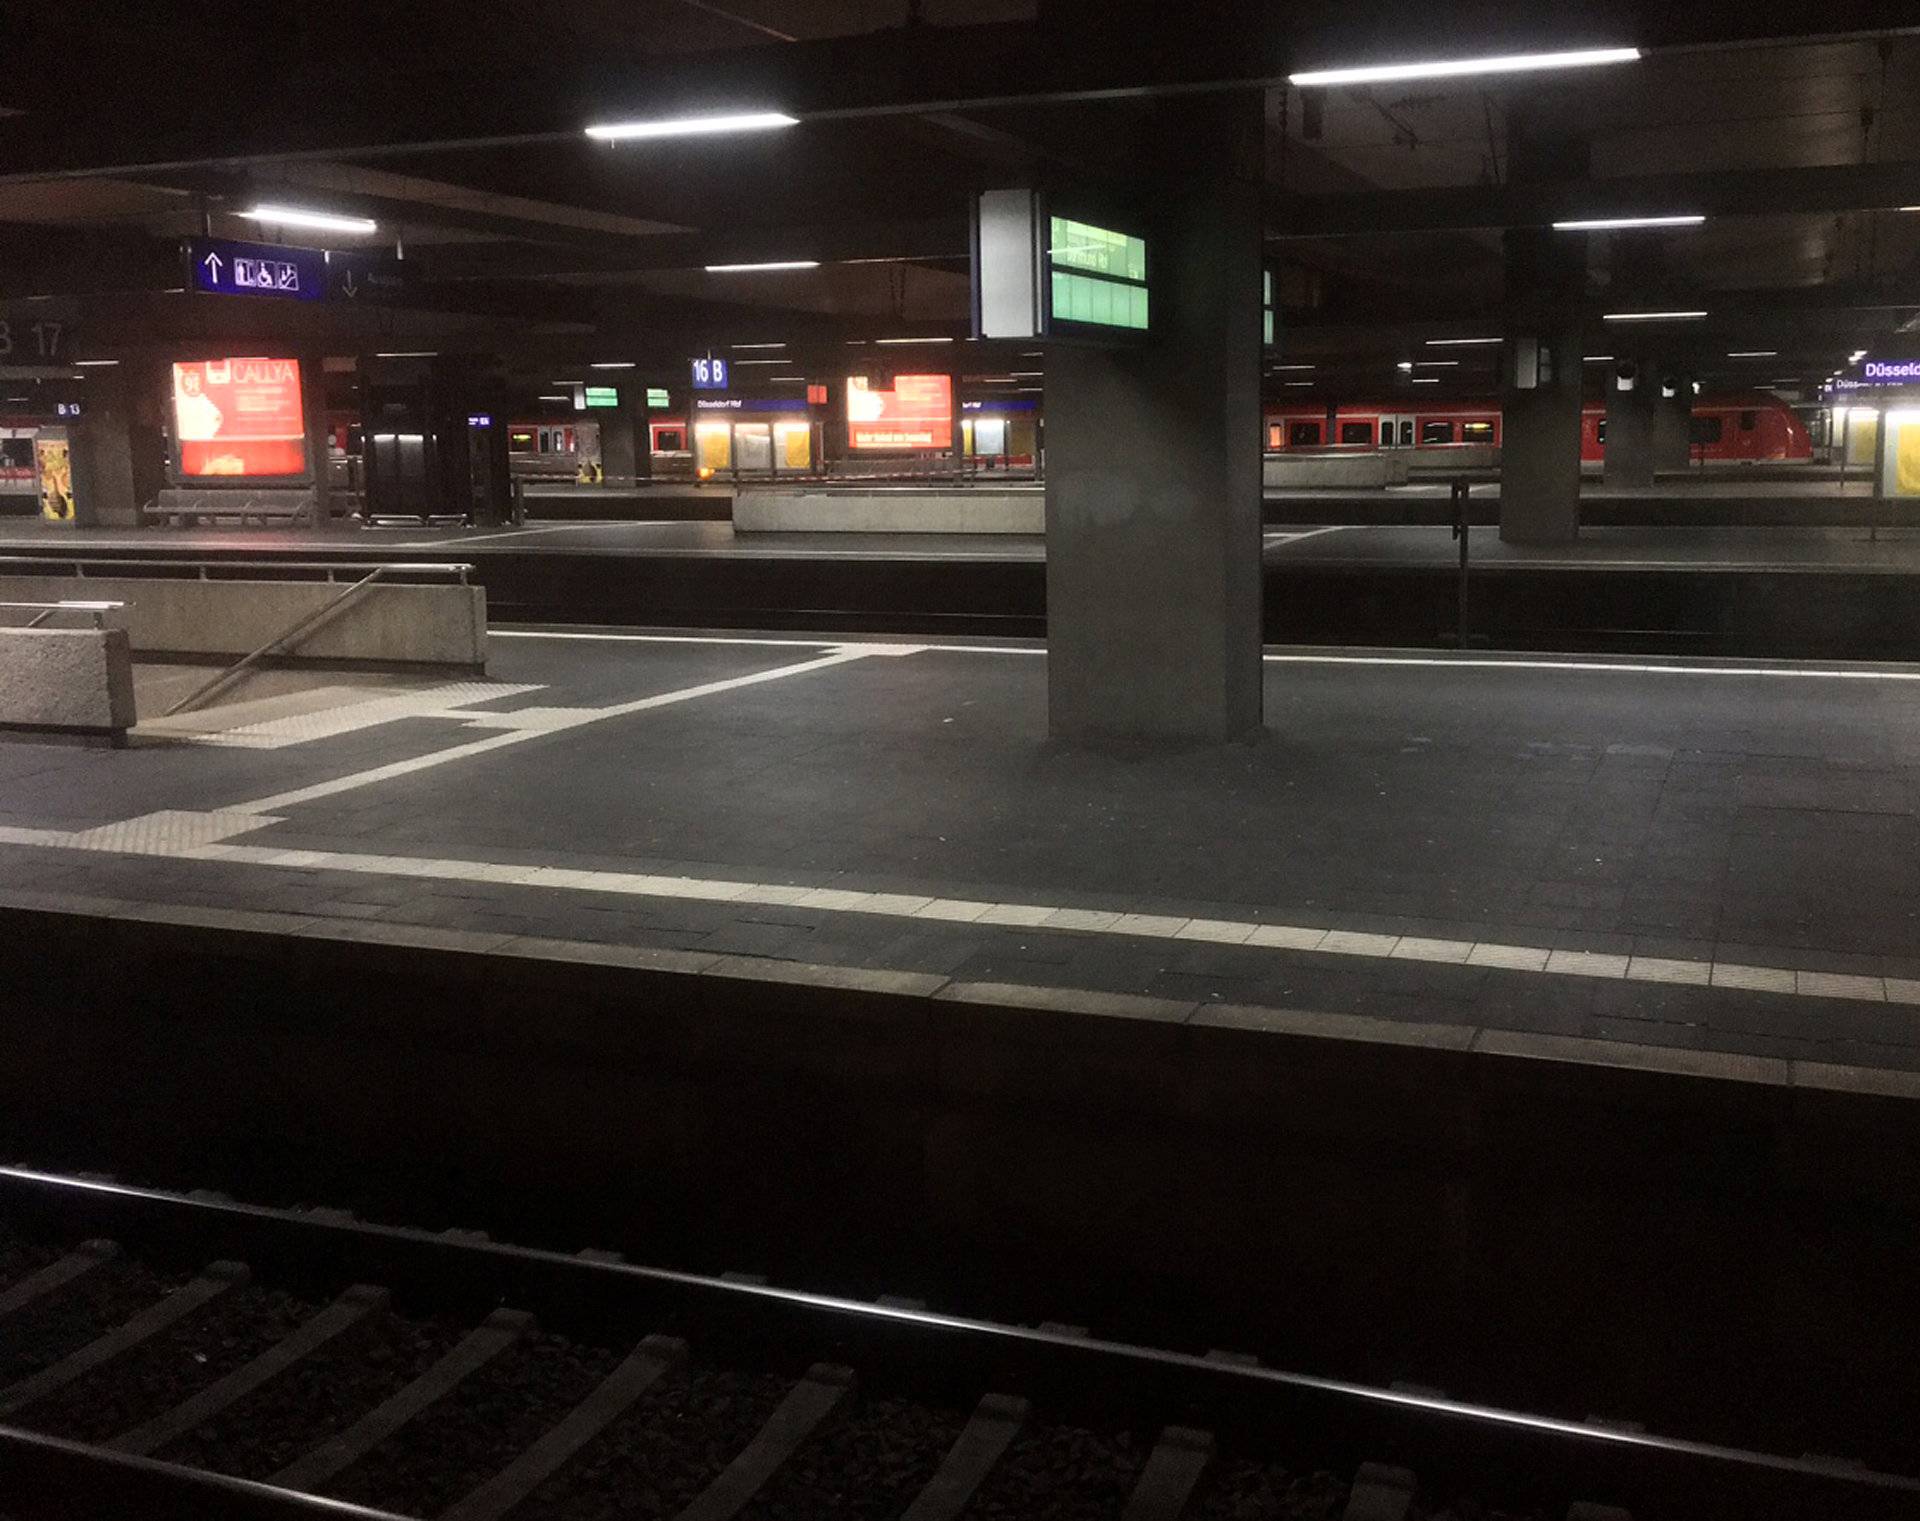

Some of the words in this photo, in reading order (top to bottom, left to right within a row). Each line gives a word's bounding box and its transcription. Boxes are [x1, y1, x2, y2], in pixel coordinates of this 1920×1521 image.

[31, 322, 61, 356] 17
[693, 359, 709, 382] 16
[712, 359, 723, 382] B
